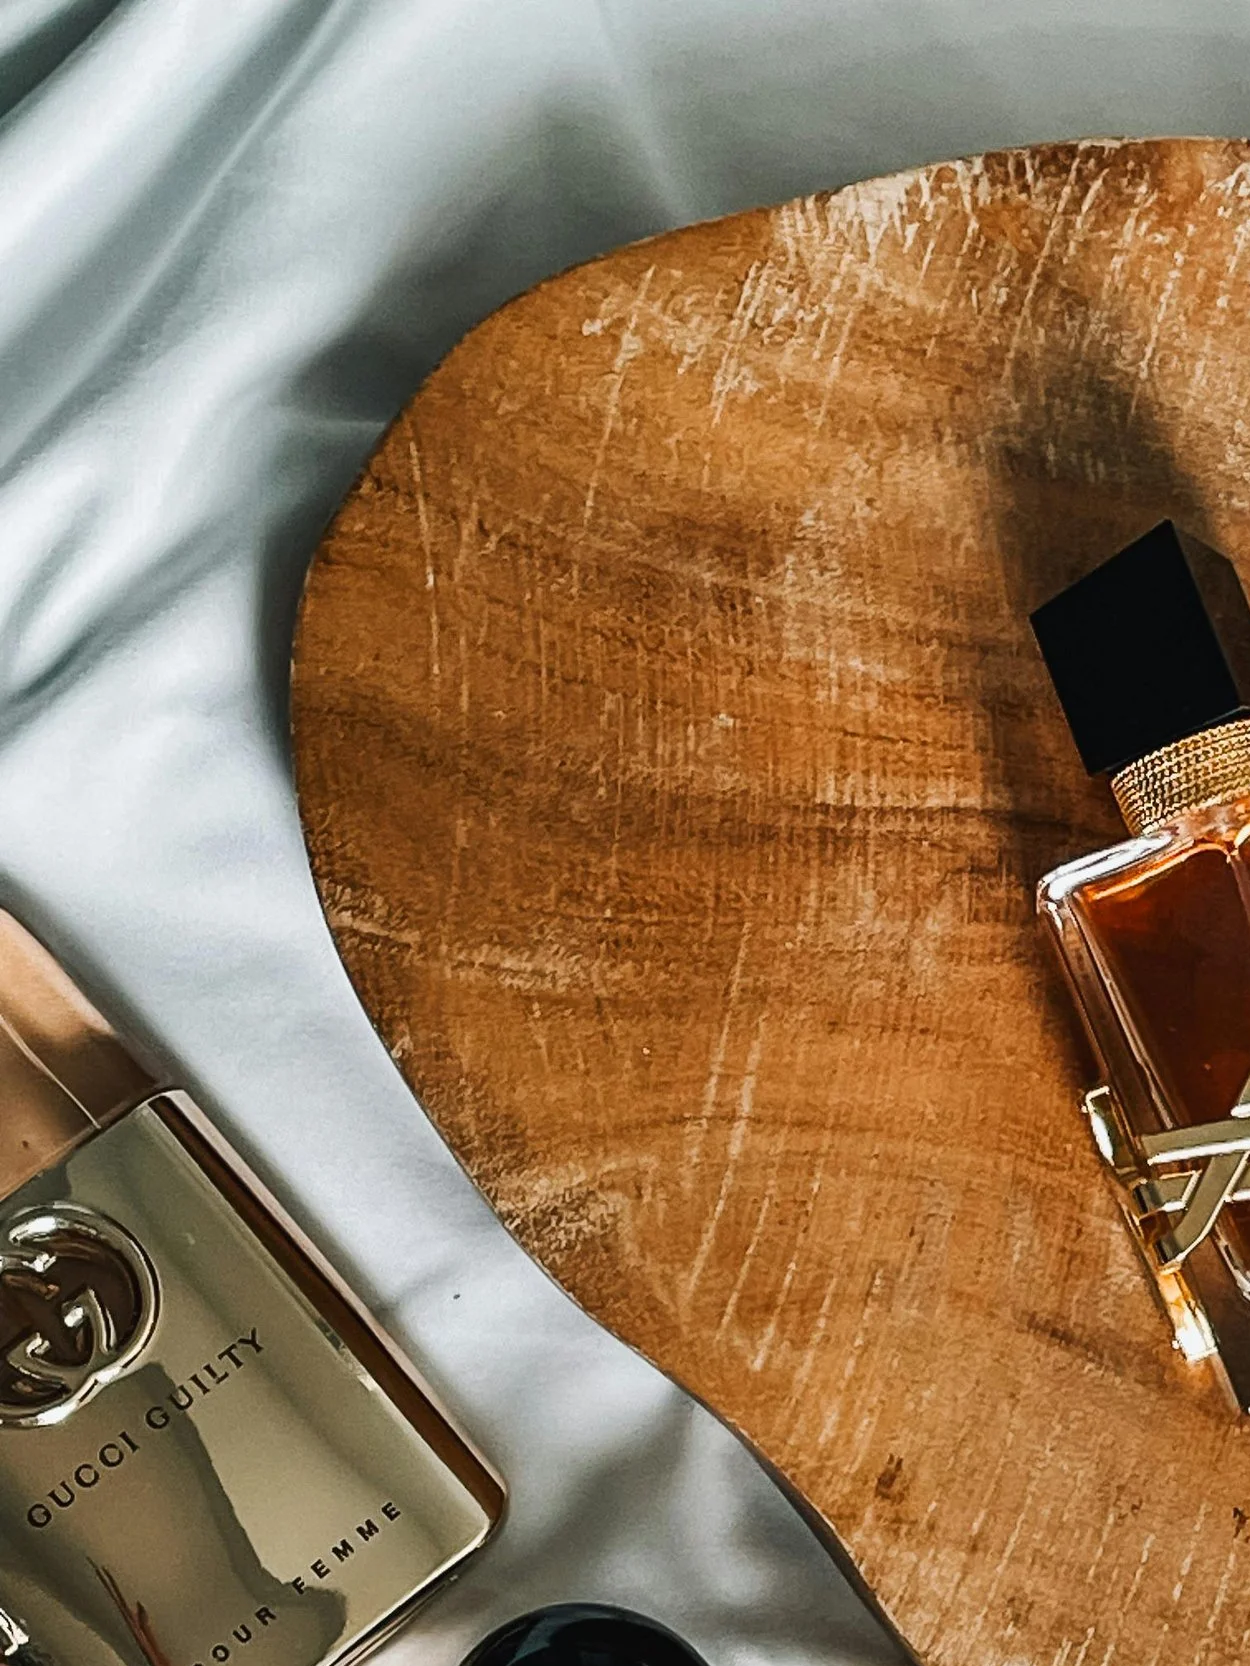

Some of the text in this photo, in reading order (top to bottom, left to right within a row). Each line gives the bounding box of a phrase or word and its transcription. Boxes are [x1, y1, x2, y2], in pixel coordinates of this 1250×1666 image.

[26, 1328, 266, 1530] GUCCI GUILTY
[292, 1502, 401, 1595] FEMME
